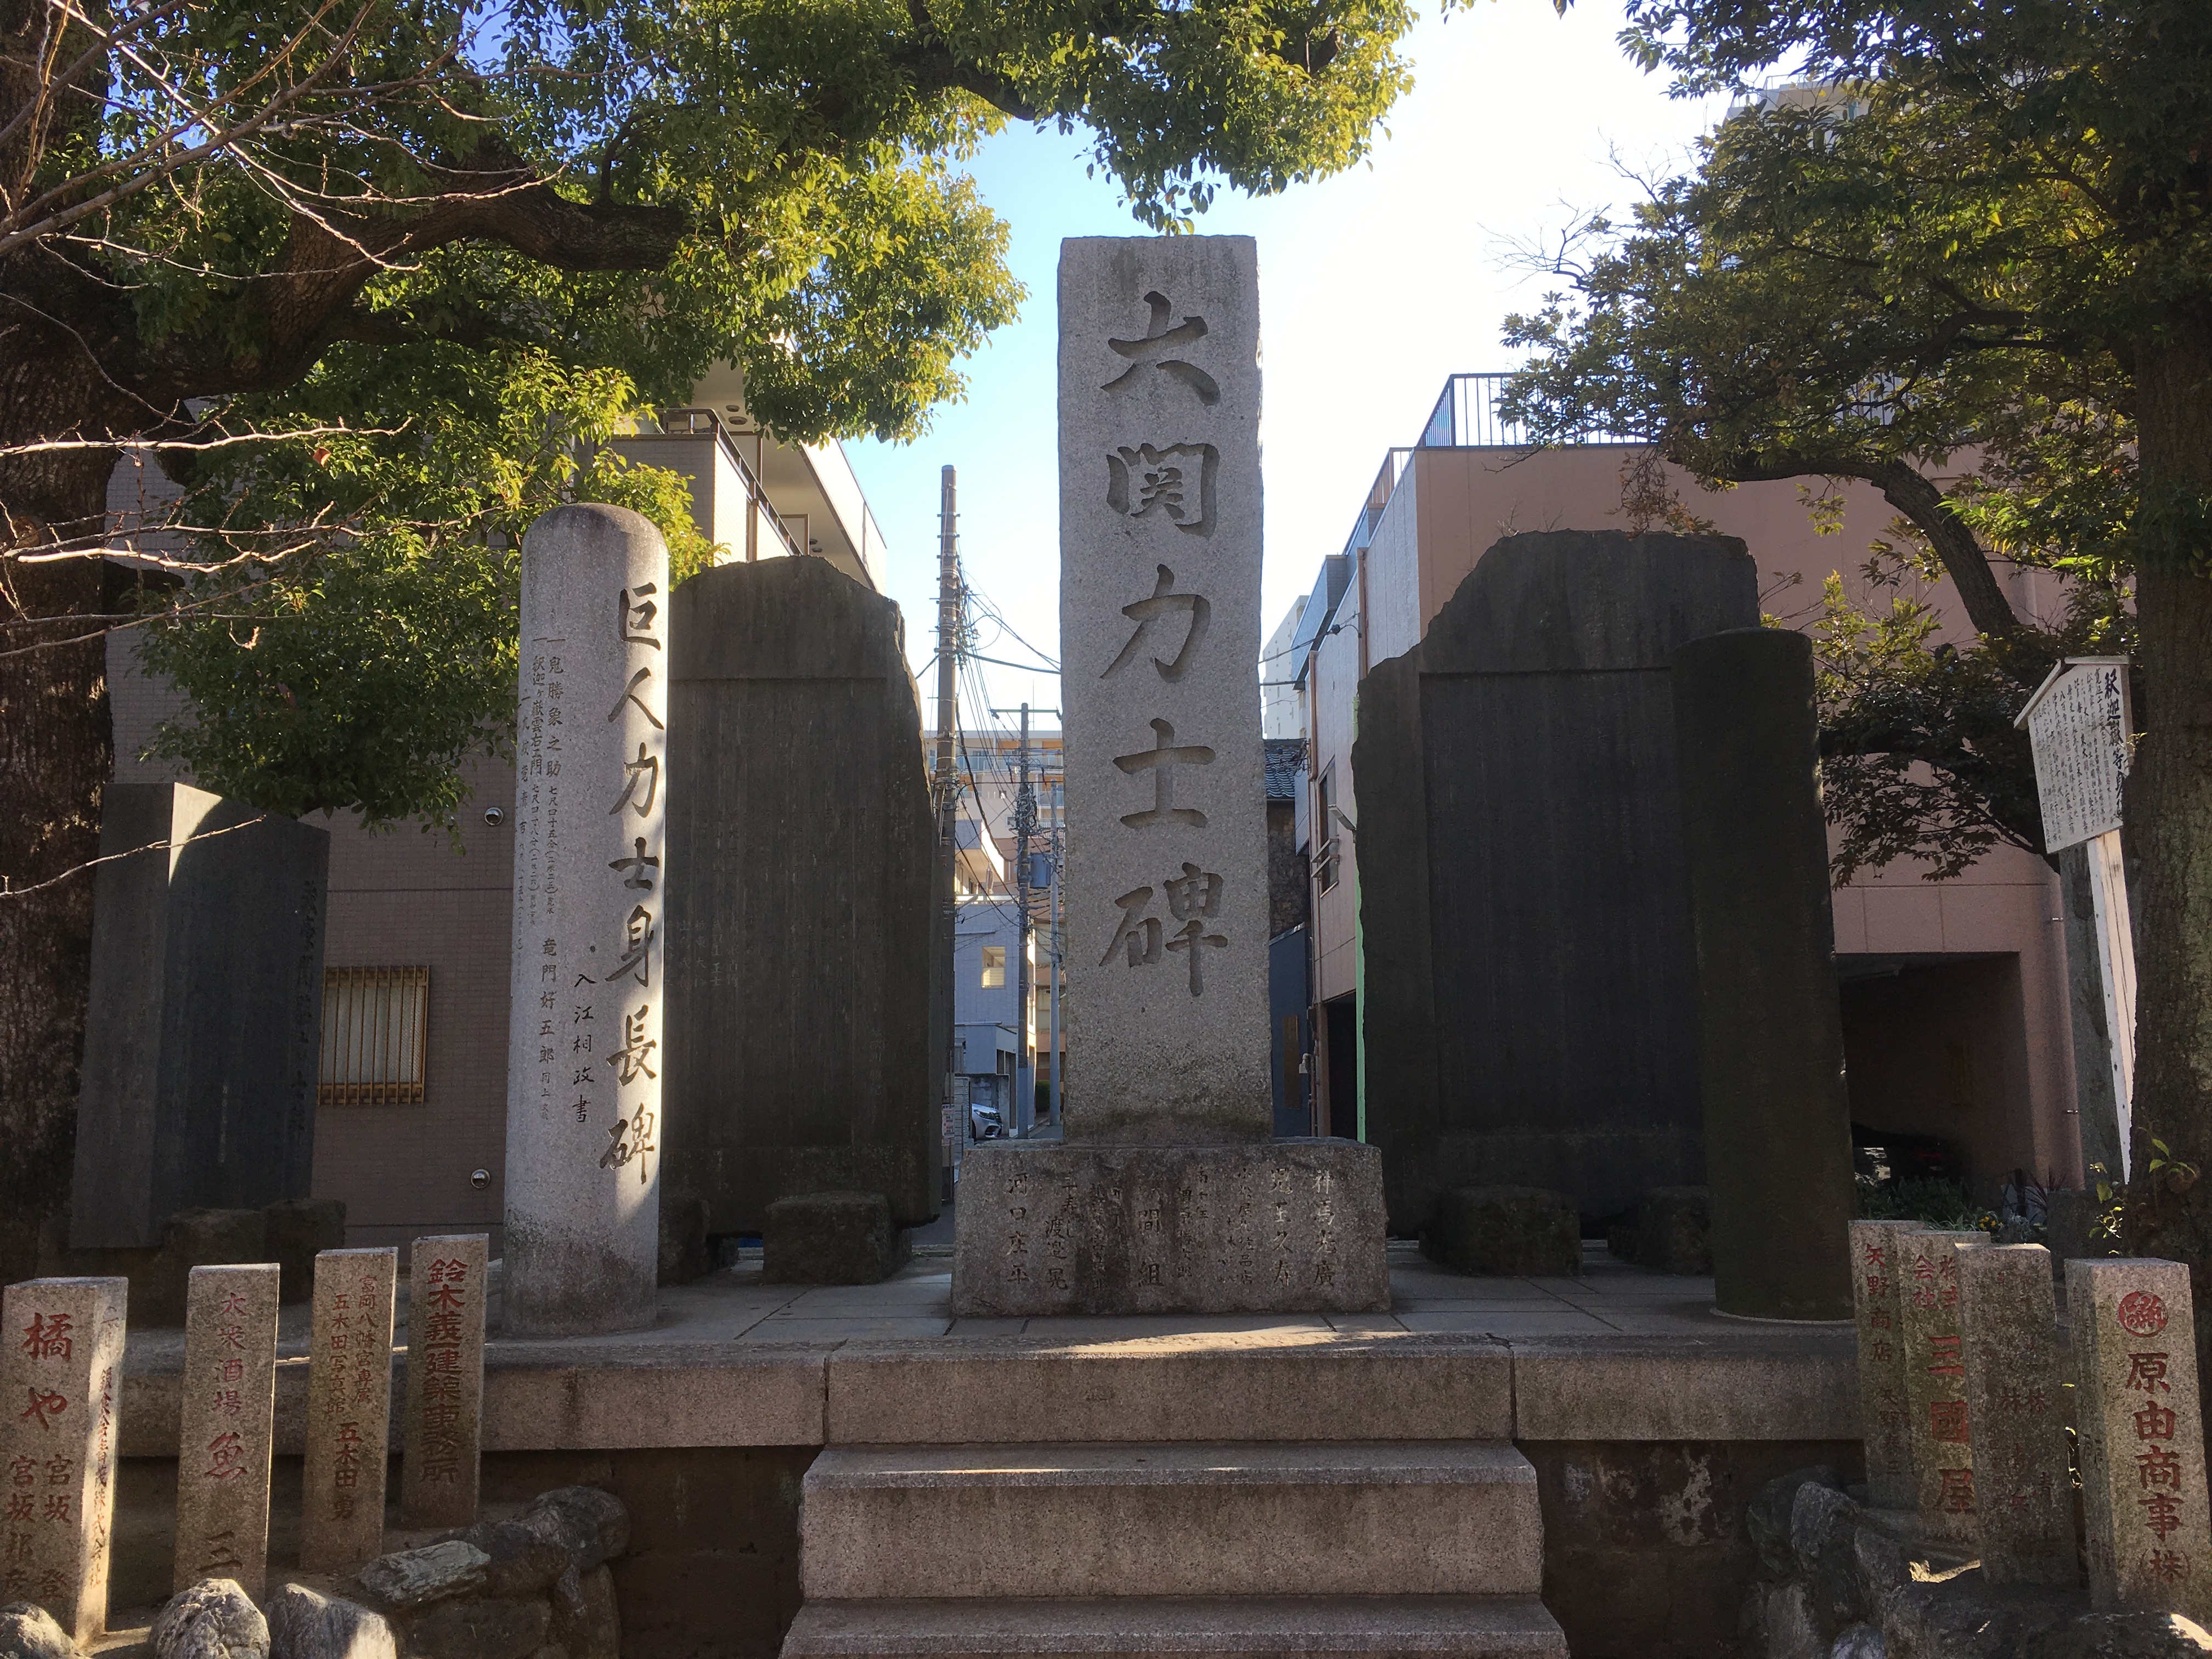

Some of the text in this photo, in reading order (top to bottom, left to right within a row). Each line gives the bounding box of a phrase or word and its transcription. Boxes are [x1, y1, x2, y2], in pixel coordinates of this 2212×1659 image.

[601, 582, 664, 1184] 巨人力士身長碑
[571, 973, 596, 1123] 入江相政書
[20, 1311, 74, 1432] 橘や
[420, 1258, 469, 1484] 鈴木義一建築事務所
[1865, 1243, 1893, 1362] 矢野商店
